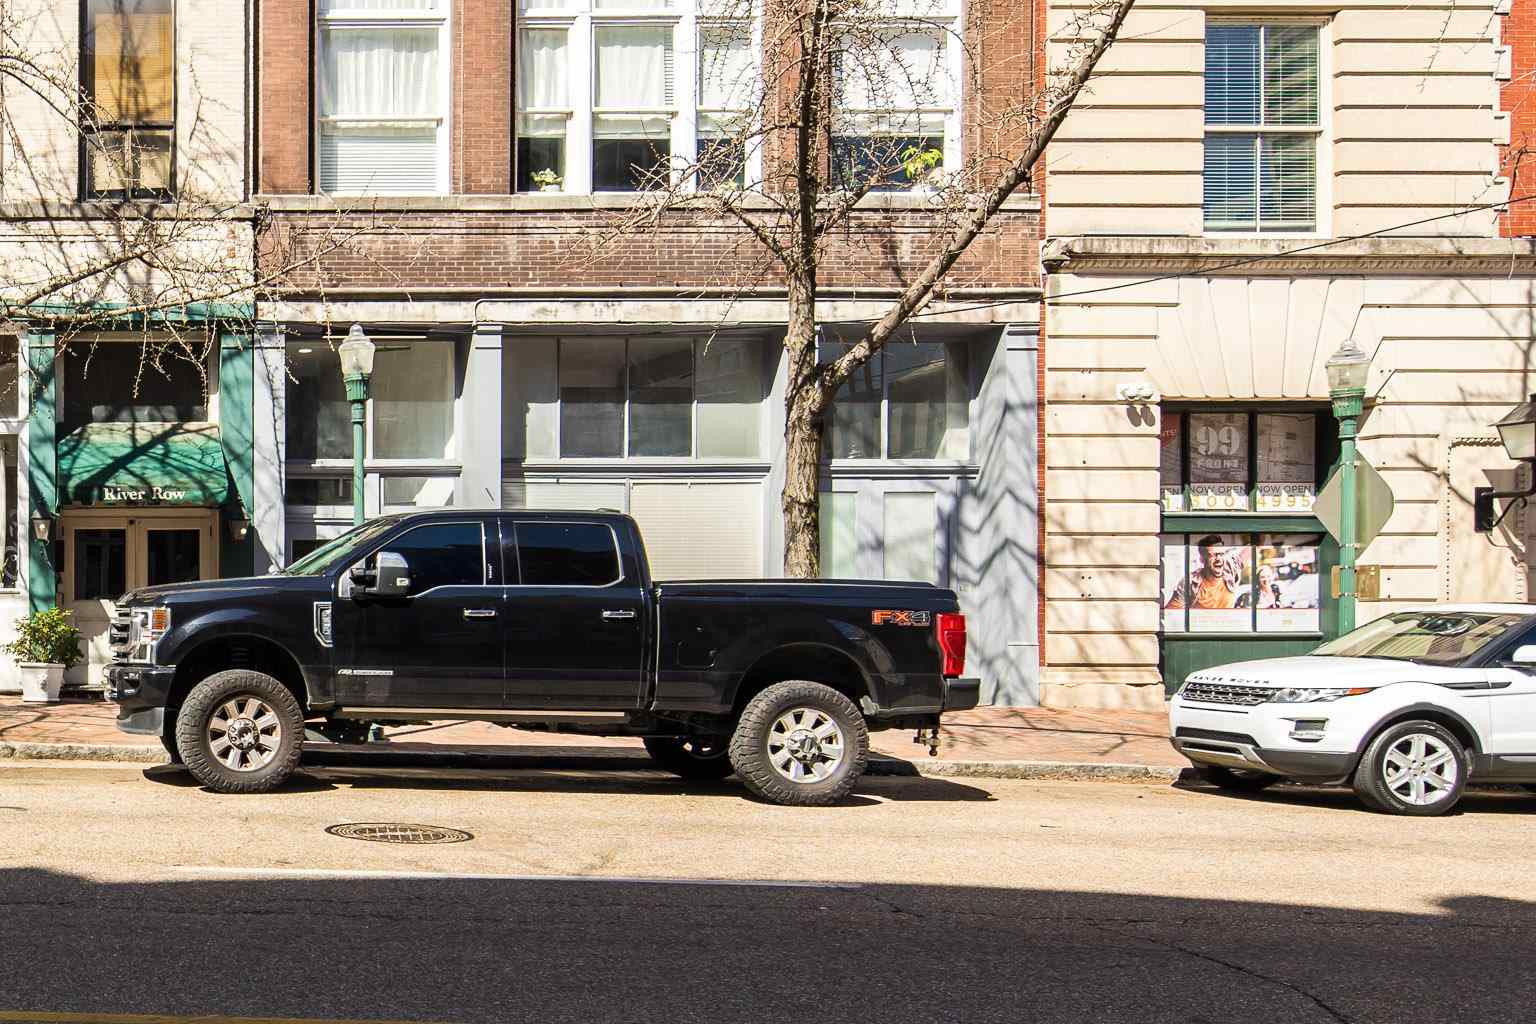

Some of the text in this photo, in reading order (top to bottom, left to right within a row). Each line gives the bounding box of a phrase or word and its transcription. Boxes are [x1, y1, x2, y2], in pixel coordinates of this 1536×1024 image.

[1197, 426, 1240, 456] 99
[104, 486, 185, 500] River Row
[1218, 485, 1246, 494] OPEN
[1284, 485, 1312, 494] OPEN
[872, 609, 931, 626] FX4
